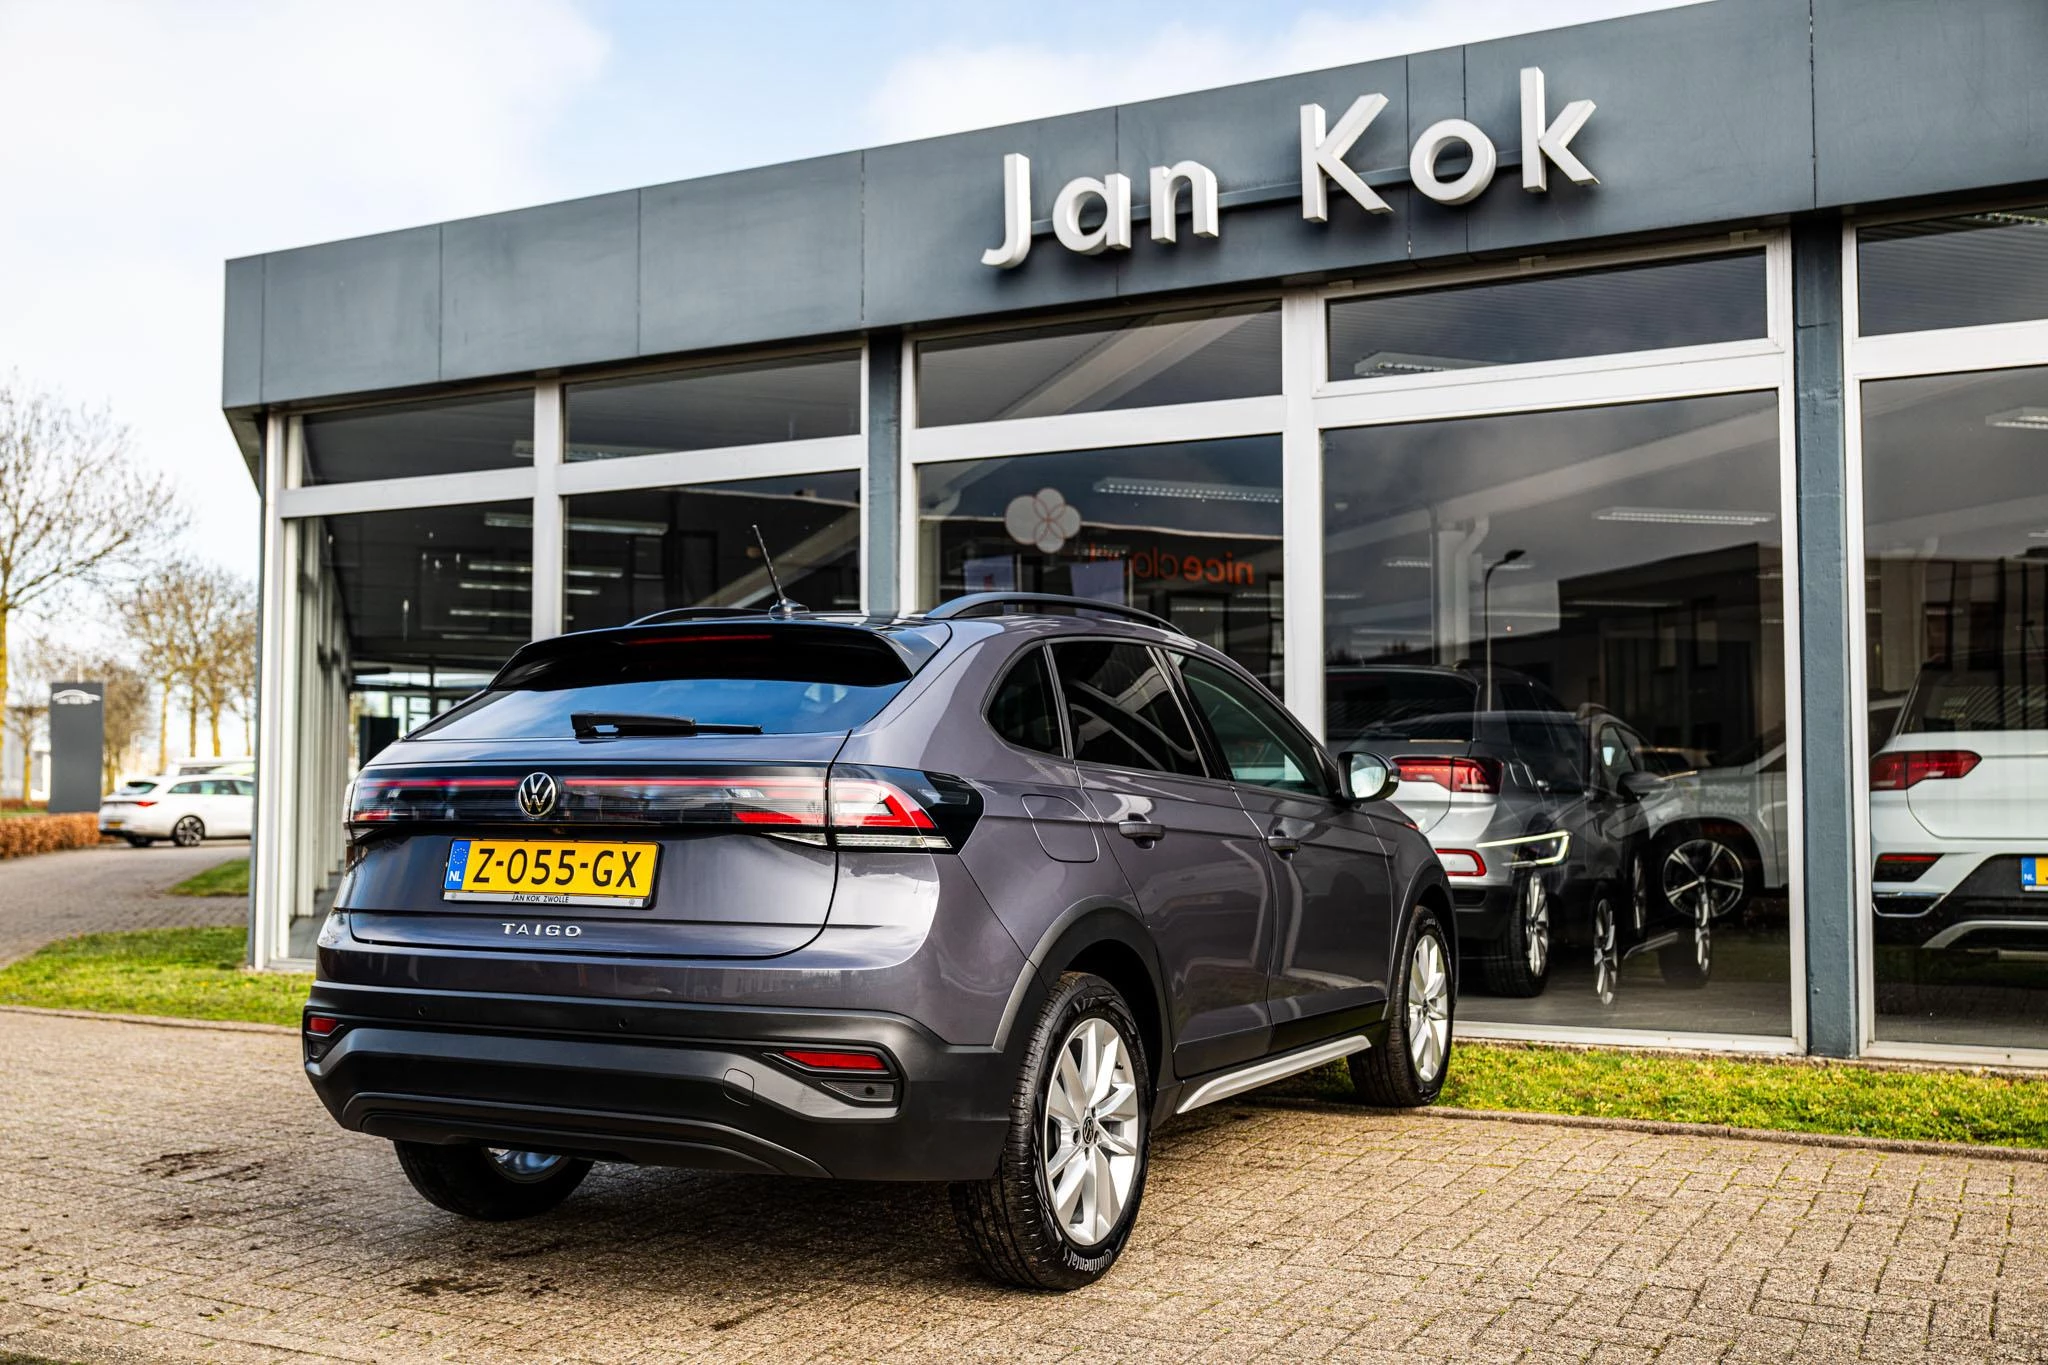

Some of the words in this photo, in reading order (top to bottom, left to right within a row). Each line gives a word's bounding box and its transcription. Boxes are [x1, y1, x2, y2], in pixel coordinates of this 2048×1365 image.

[981, 152, 1219, 269] Jan
[1300, 66, 1600, 223] Kok
[472, 848, 642, 888] Z-055-GX
[449, 871, 462, 882] NL
[511, 894, 526, 902] JAN
[526, 895, 541, 903] KOK
[543, 895, 570, 904] ZWOLLE
[501, 922, 583, 937] TAIGO
